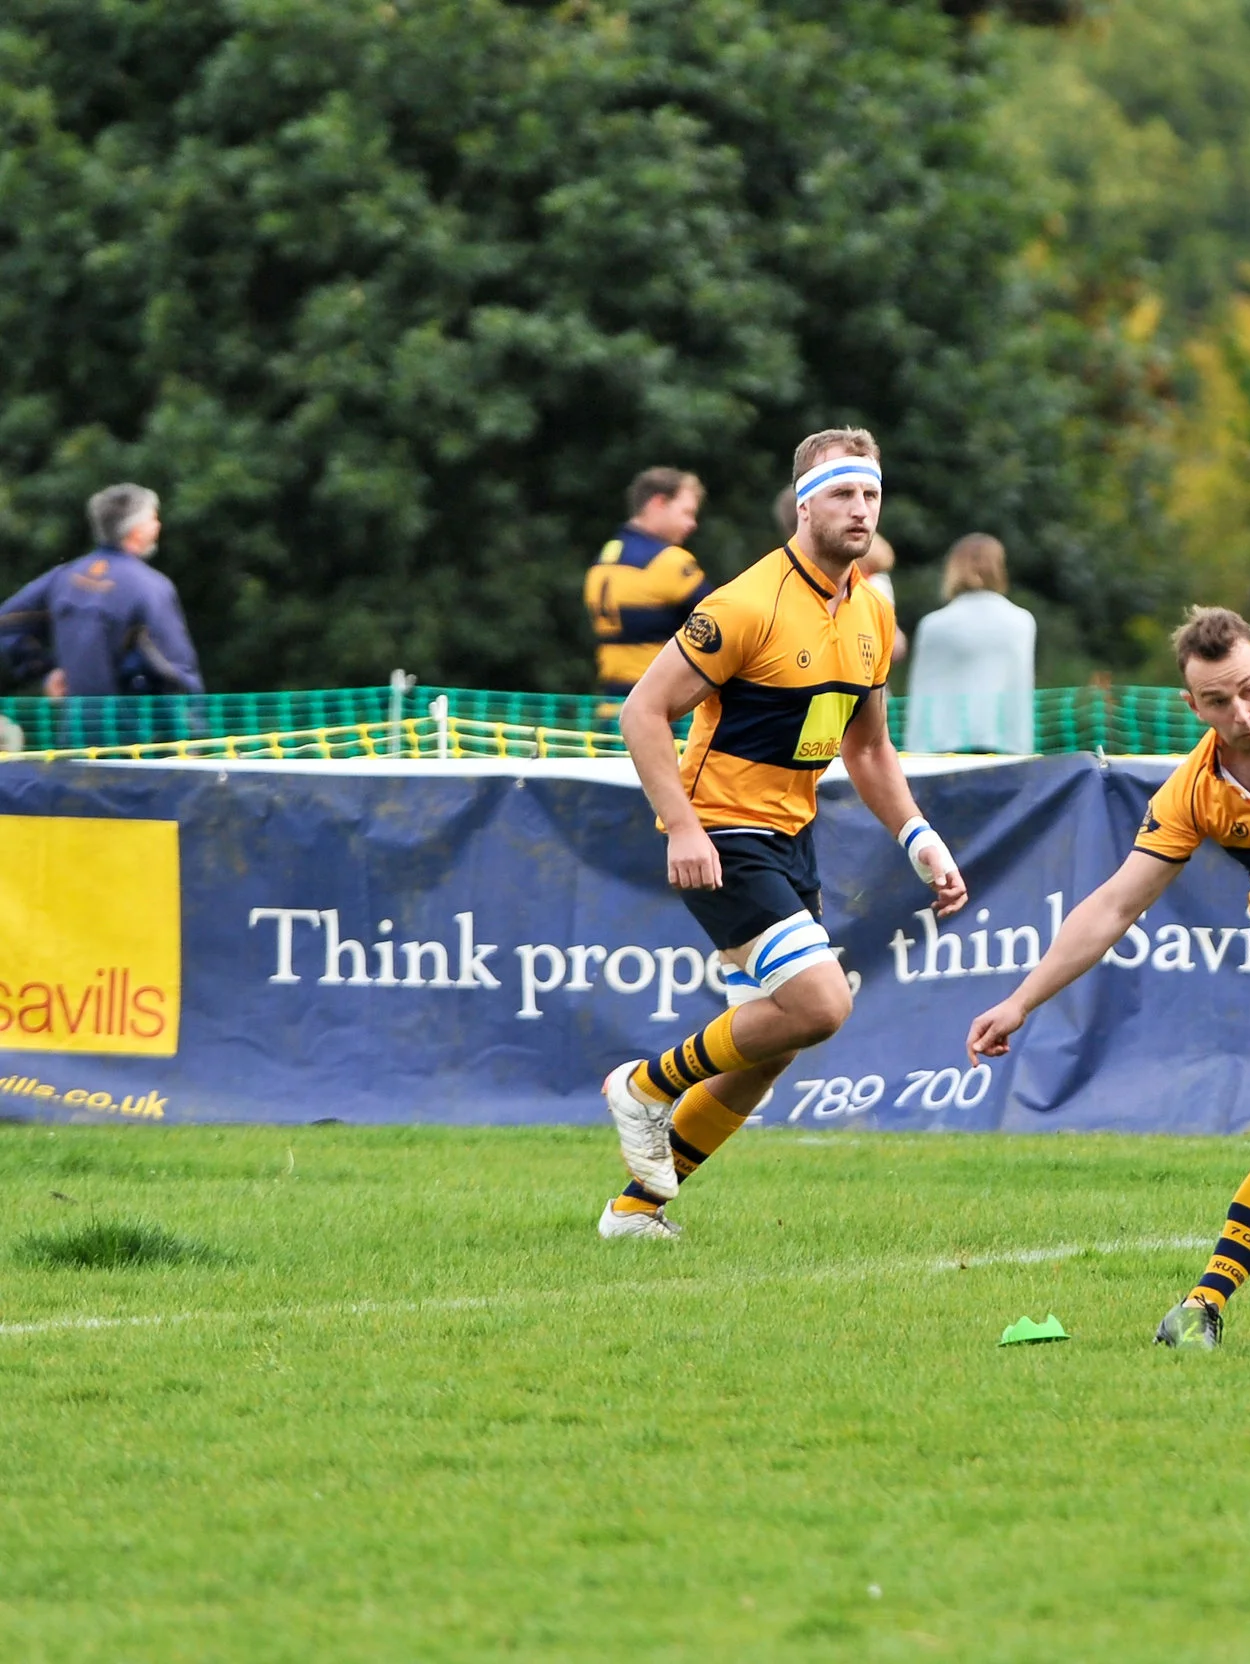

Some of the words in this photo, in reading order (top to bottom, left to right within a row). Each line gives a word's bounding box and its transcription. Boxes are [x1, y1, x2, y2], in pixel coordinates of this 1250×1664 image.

[249, 907, 501, 989] Think
[513, 944, 862, 1022] prope,
[788, 1074, 885, 1123] 789
[893, 1063, 992, 1111] 700
[1231, 1226, 1242, 1235] 7
